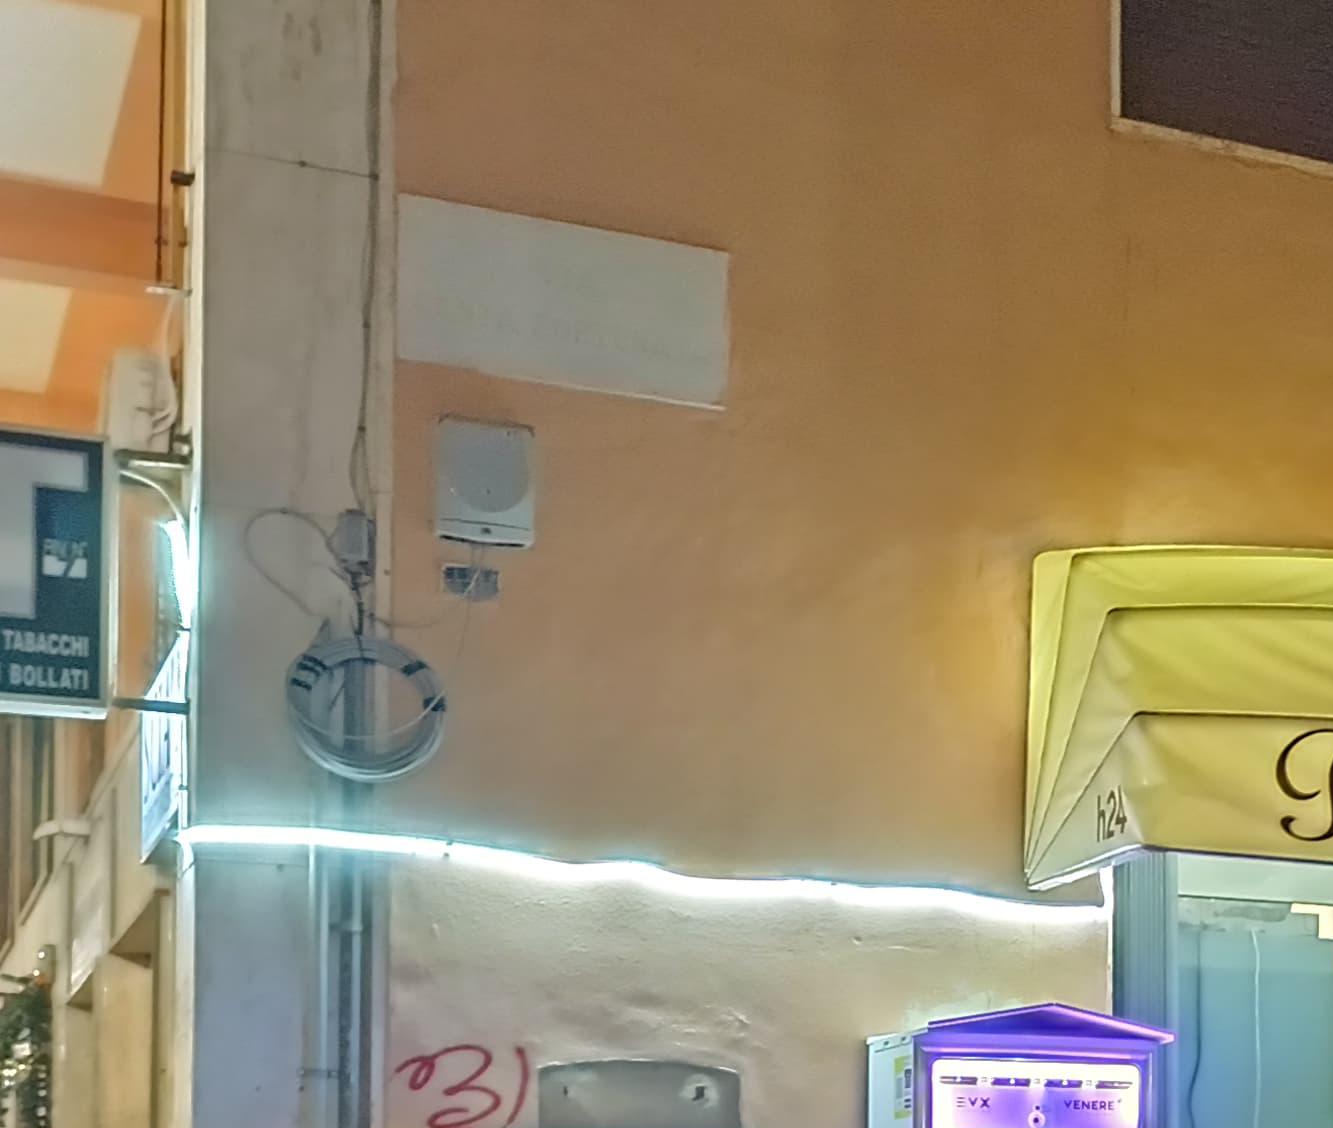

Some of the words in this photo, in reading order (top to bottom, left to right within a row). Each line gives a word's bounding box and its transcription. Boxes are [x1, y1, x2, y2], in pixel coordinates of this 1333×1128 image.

[2, 629, 90, 658] TABACCHI
[8, 662, 90, 690] BOLLATI
[1096, 785, 1128, 843] h24
[1063, 1099, 1115, 1111] VENERE
